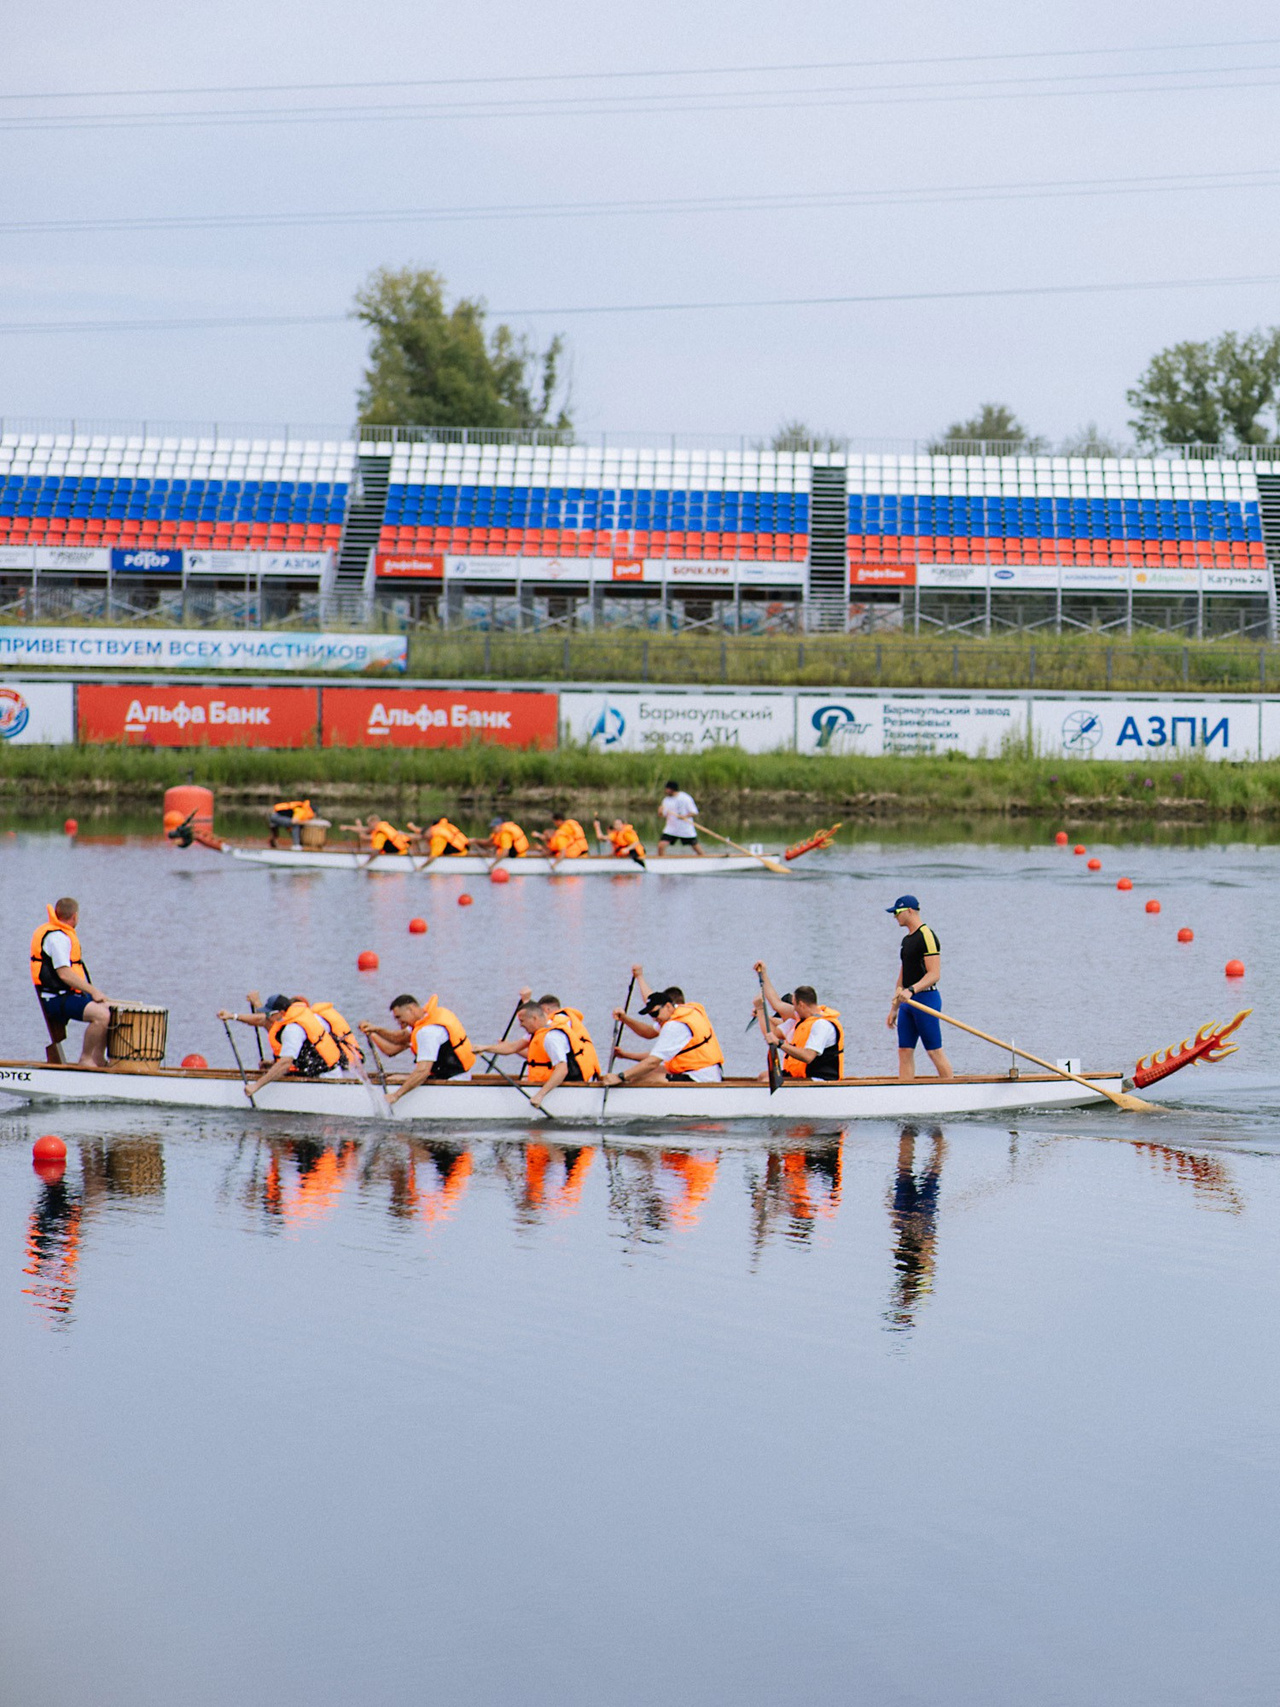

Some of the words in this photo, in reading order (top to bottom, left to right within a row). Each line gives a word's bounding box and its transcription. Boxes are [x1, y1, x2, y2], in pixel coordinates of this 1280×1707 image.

[1208, 574, 1247, 585] Катунь
[1250, 575, 1263, 584] 24
[0, 638, 163, 656] ПРИВЕТСТВУЕМ
[170, 640, 222, 657] ВСЕХ
[229, 641, 367, 660] УЧАСТНИКОВ
[126, 699, 206, 731] Альфа
[210, 702, 271, 726] Банк
[368, 703, 448, 734] Альфа
[452, 705, 512, 729] Банк
[639, 702, 773, 726] Барнаульский
[883, 704, 970, 717] Барнаульский
[975, 708, 1011, 717] завод
[700, 727, 740, 744] АТИ
[1116, 715, 1230, 748] АЗПИ
[1064, 1060, 1071, 1073] 1
